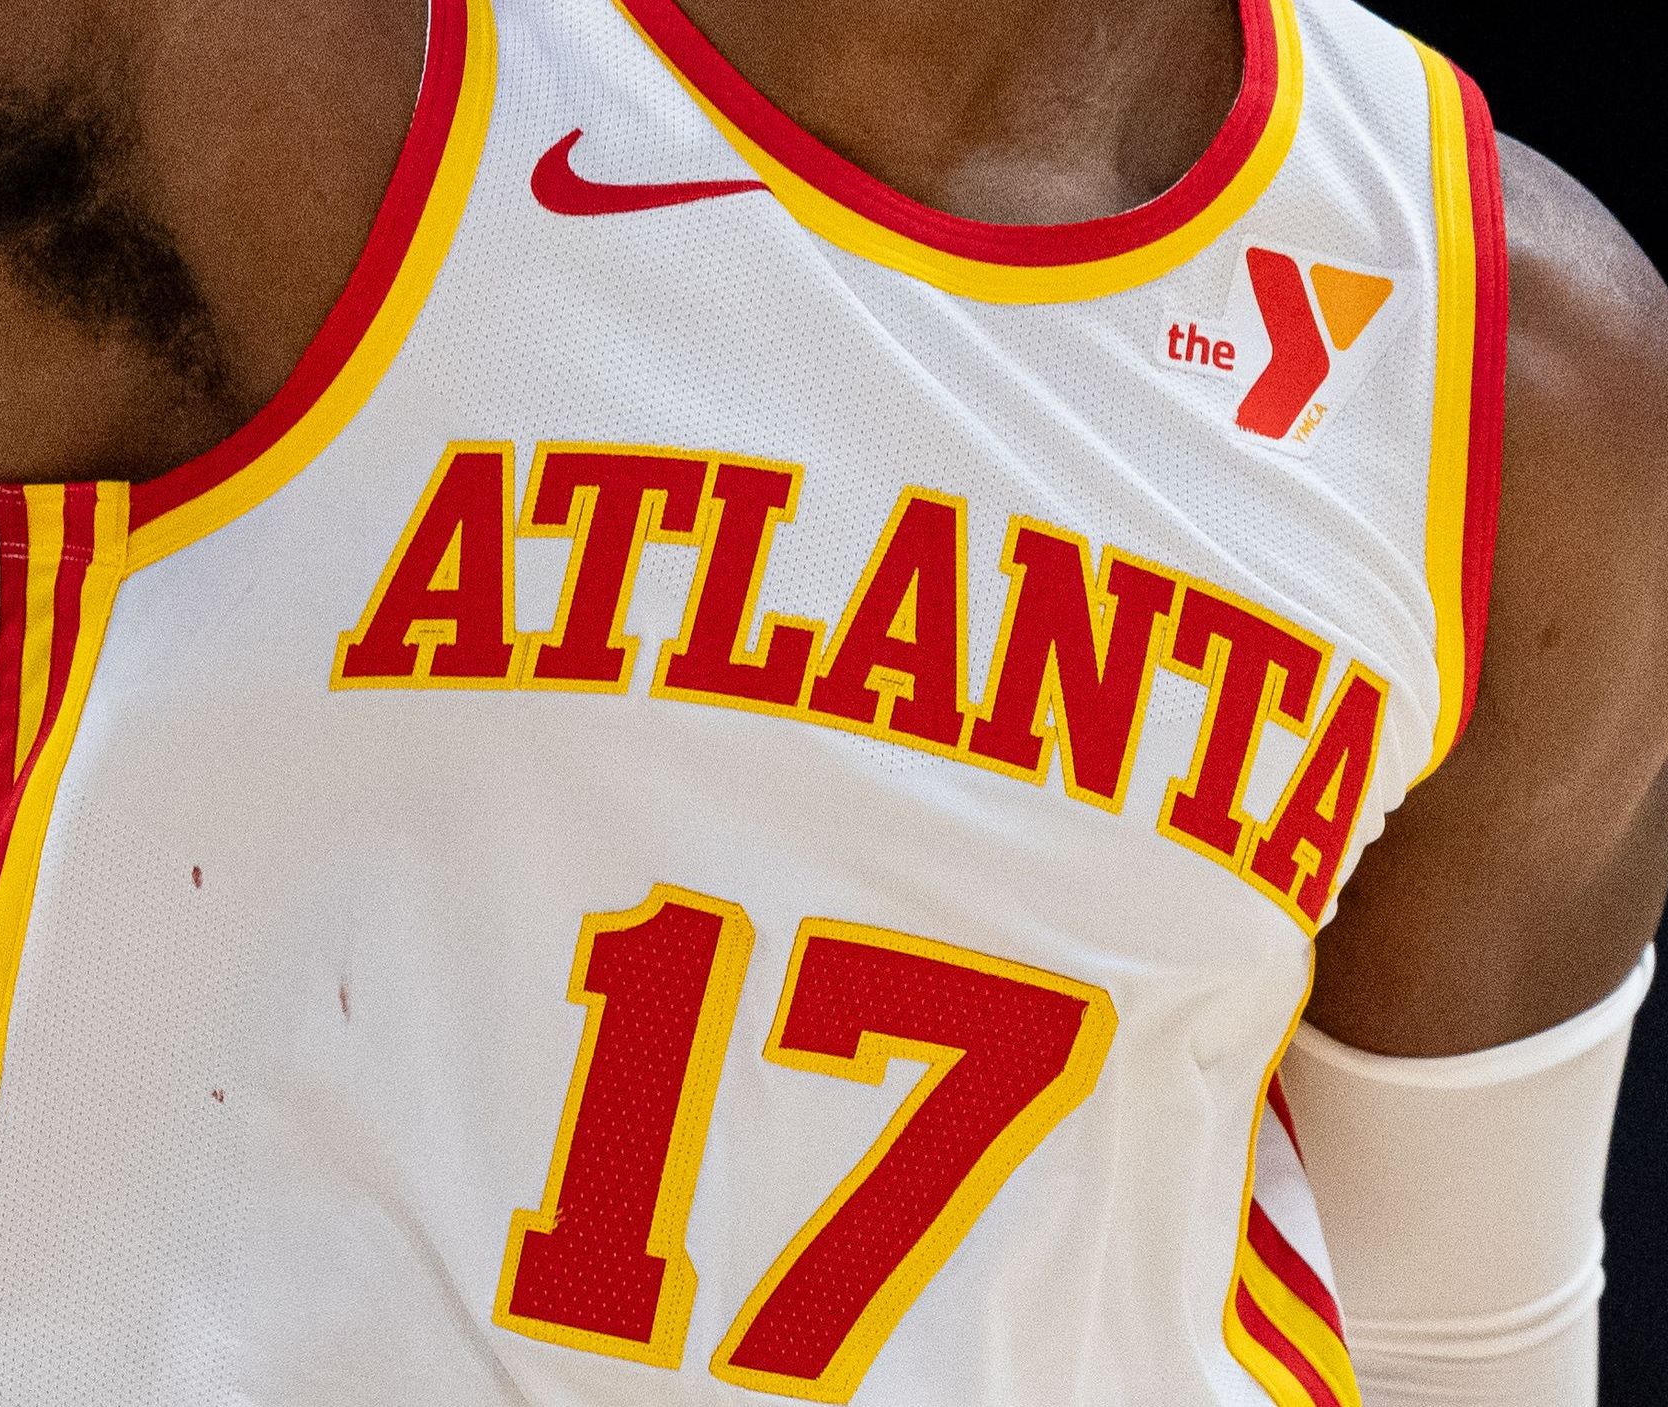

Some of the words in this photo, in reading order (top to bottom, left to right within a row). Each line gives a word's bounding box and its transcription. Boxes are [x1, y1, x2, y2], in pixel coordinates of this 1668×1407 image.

[1168, 322, 1236, 371] the
[1293, 402, 1328, 443] YMCA
[332, 440, 1389, 938] ATLANTA
[492, 884, 1119, 1404] 17
